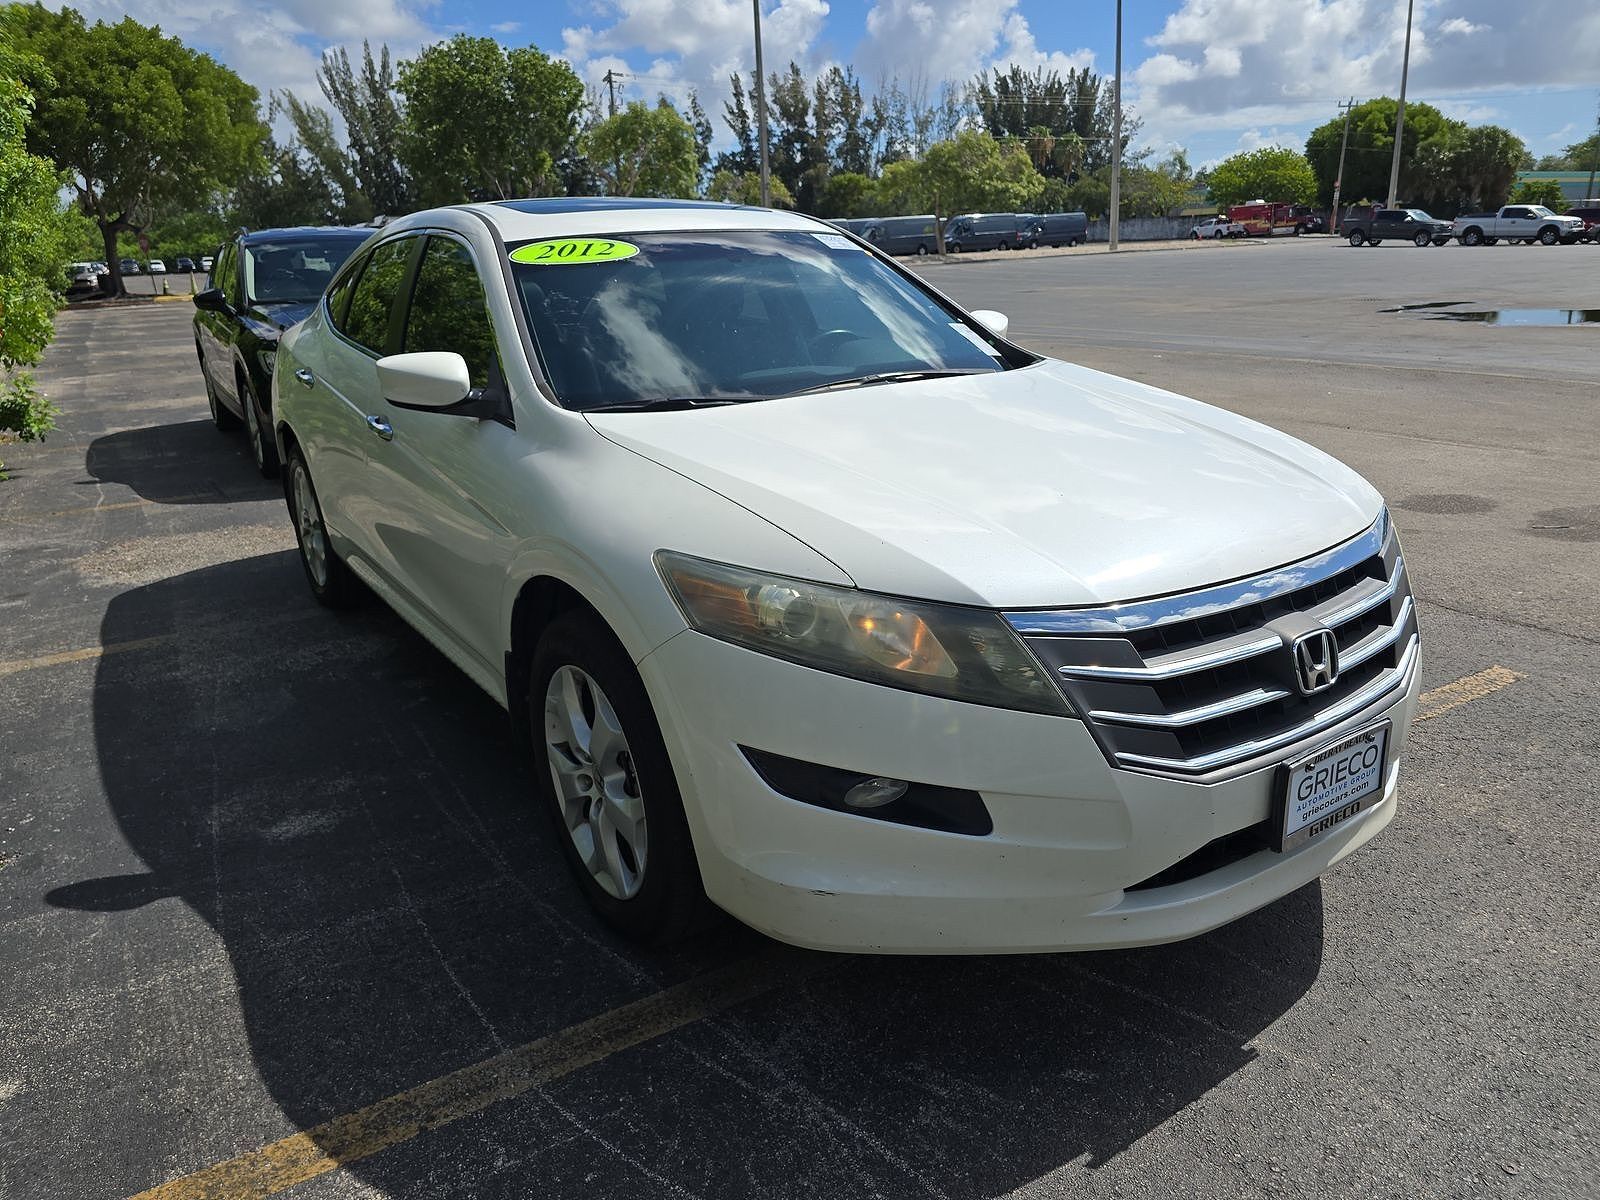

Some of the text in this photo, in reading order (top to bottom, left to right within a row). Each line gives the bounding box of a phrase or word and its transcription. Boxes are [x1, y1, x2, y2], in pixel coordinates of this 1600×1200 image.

[535, 243, 615, 259] 2012
[1297, 768, 1375, 812] AUTOMOTIVE GROUP
[1298, 745, 1378, 801] GRIECO
[1302, 781, 1368, 821] griecocars.com
[1309, 802, 1360, 837] GRIECO
